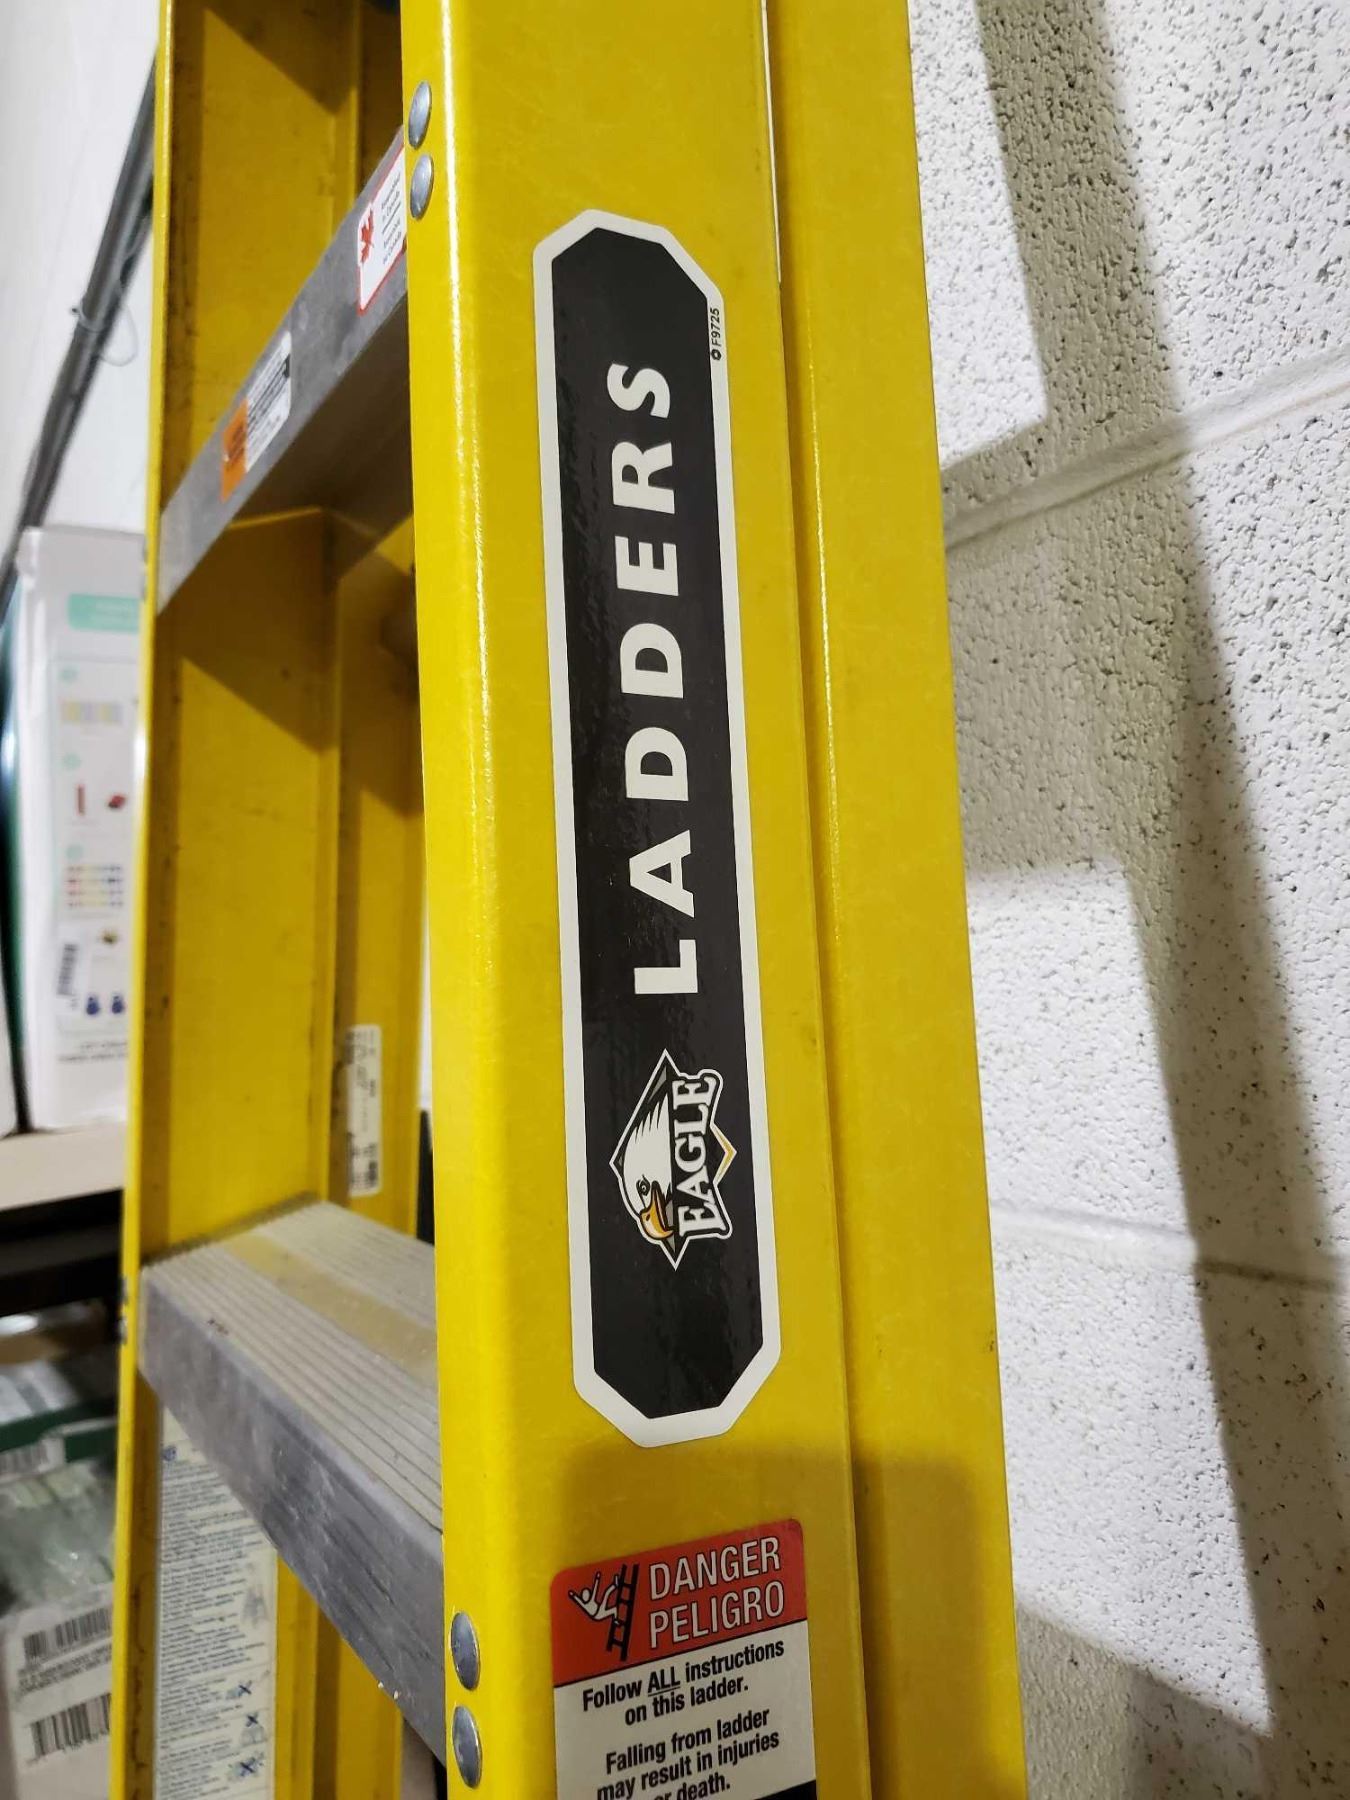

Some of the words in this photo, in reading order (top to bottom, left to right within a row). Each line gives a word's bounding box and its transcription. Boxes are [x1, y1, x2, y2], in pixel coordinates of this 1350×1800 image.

[709, 307, 722, 347] F9725
[606, 362, 699, 995] LADDERS
[671, 1075, 729, 1238] EAGLE
[649, 1536, 782, 1601] DANGER
[649, 1580, 785, 1650] PELIGRO
[582, 1680, 643, 1712] Follow
[648, 1666, 681, 1695] ALL
[685, 1640, 785, 1683] instructions
[625, 1706, 647, 1725] on
[653, 1691, 685, 1718] this
[690, 1676, 749, 1706] ladder.
[597, 1777, 636, 1800] may
[641, 1756, 692, 1791] result
[696, 1751, 713, 1771] in
[717, 1731, 780, 1768] injuries
[606, 1742, 666, 1774] Falling
[671, 1727, 712, 1754] from
[717, 1708, 770, 1744] ladder
[676, 1773, 731, 1800] death.
